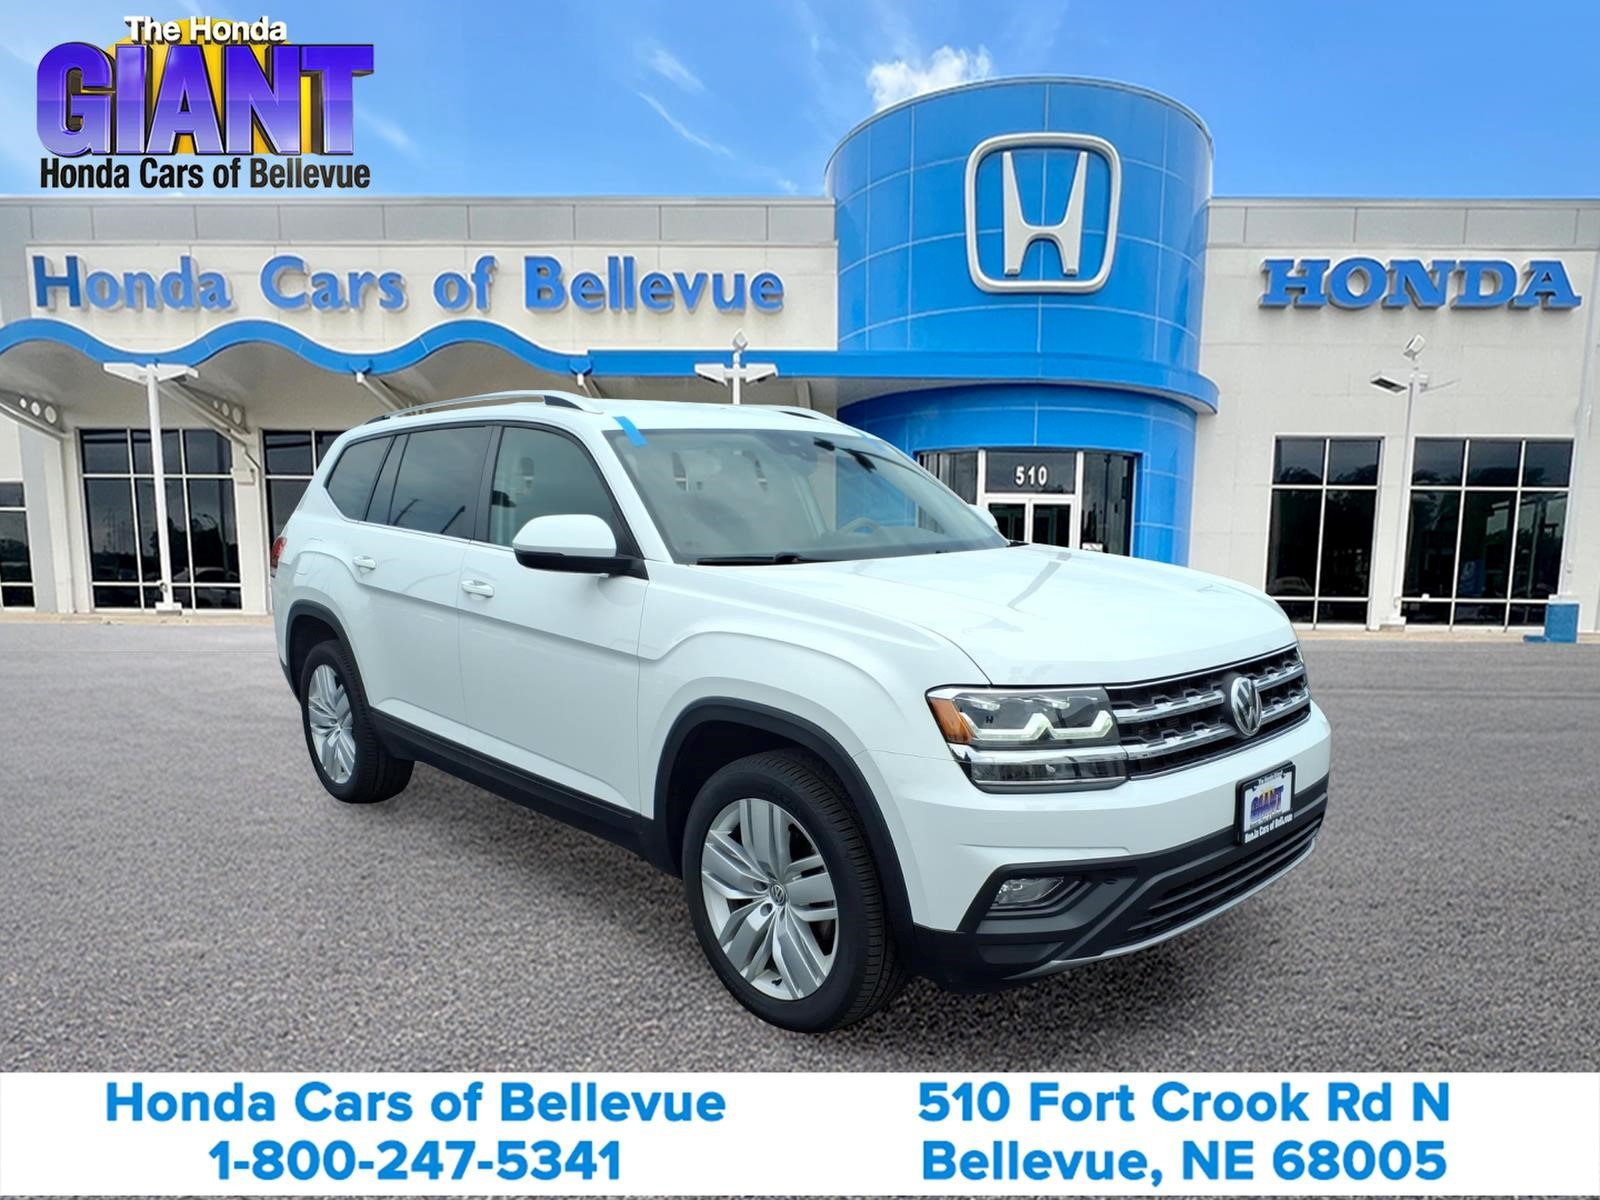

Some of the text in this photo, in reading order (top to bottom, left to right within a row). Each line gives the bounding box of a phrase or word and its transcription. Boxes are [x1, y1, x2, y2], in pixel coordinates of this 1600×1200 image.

[32, 255, 785, 312] Honda Cars of Bellevue
[1260, 257, 1582, 309] HONDA
[1014, 465, 1048, 487] 510
